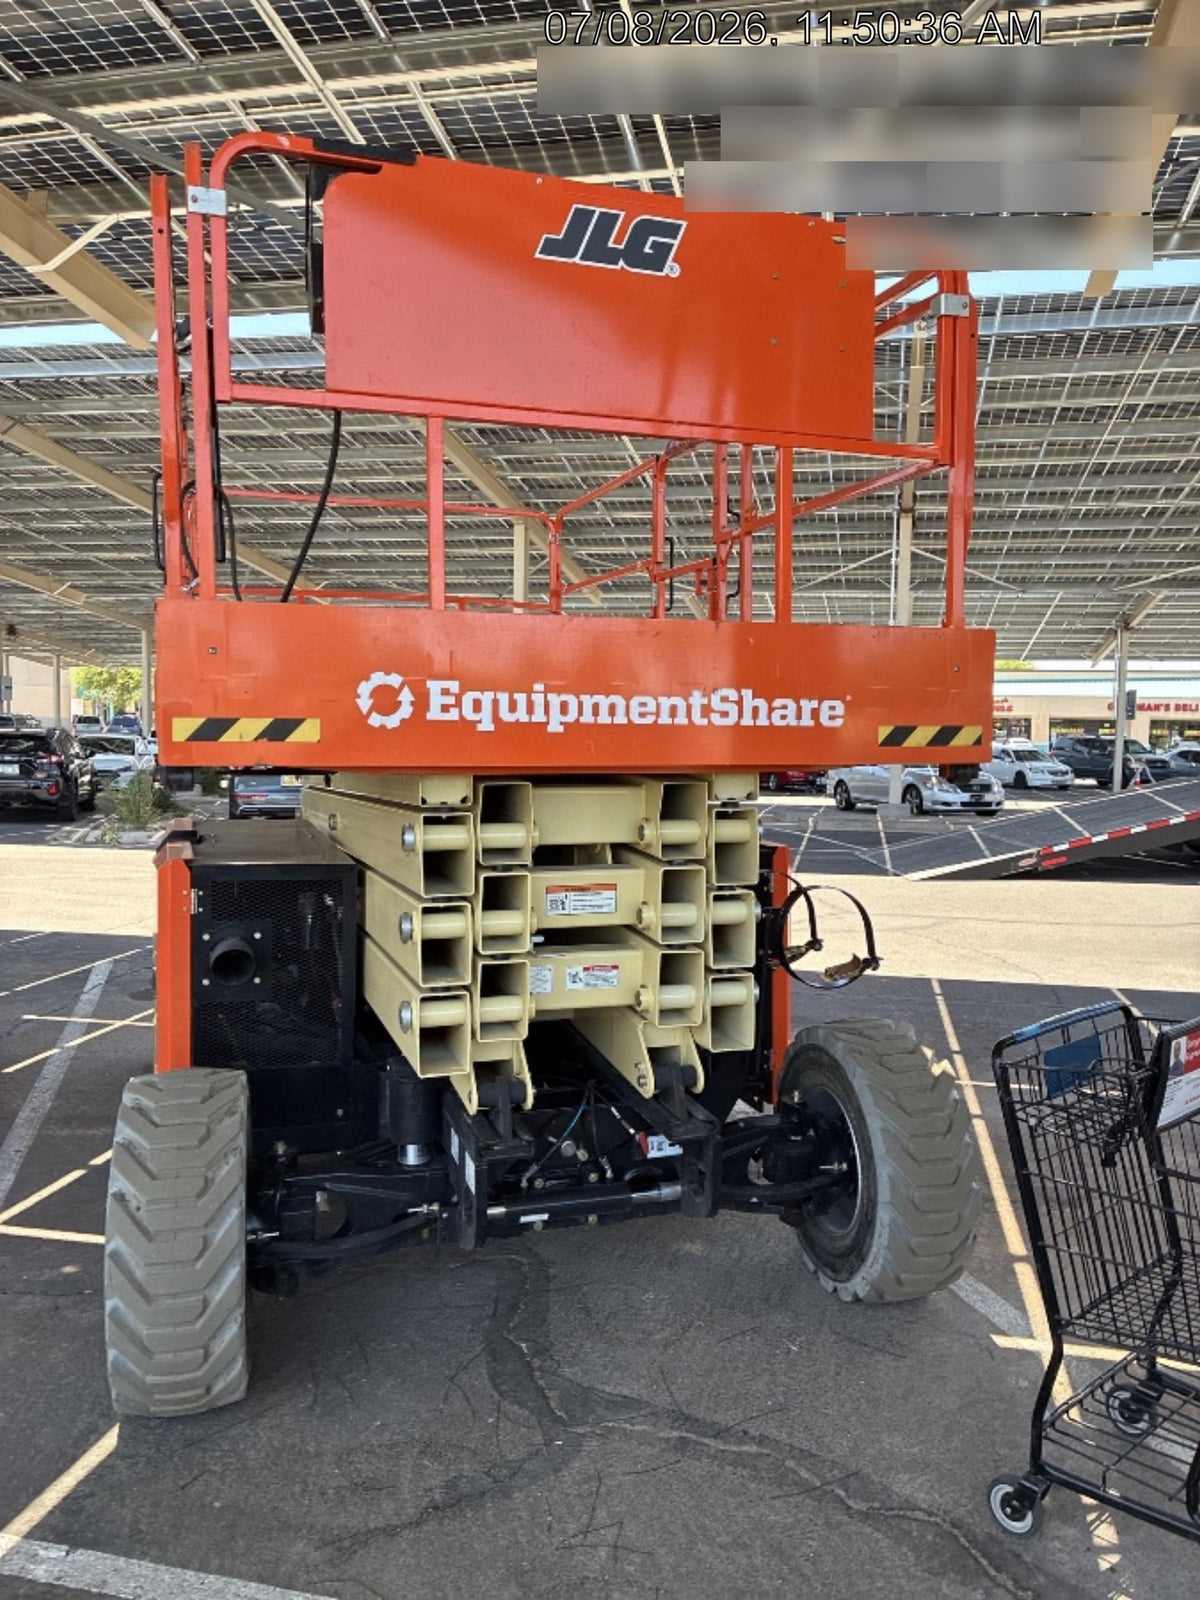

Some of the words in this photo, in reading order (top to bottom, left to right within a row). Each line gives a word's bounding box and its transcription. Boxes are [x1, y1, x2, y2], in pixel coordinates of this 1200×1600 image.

[534, 203, 688, 276] JLG
[426, 679, 846, 732] EquipmentShare
[1174, 703, 1199, 712] DELI
